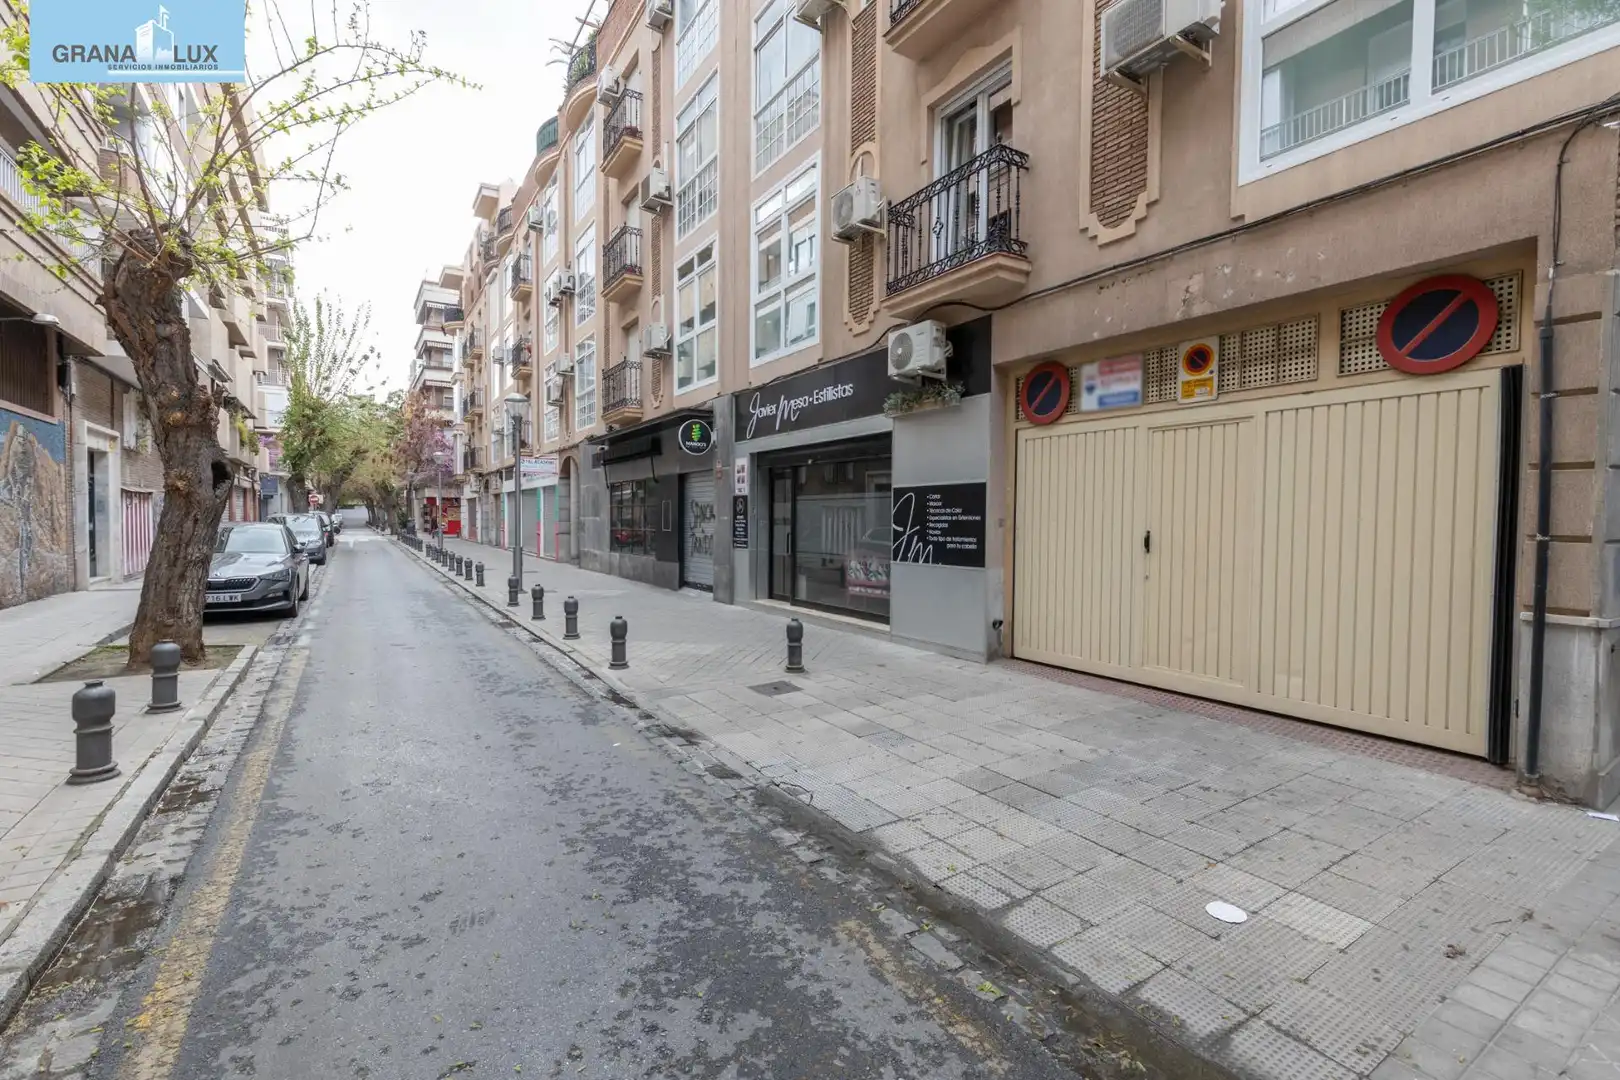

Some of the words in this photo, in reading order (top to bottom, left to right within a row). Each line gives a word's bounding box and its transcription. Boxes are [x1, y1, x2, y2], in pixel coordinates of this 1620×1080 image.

[746, 392, 777, 439] Javier
[775, 394, 809, 431] Mesa
[813, 383, 854, 405] Estilistas
